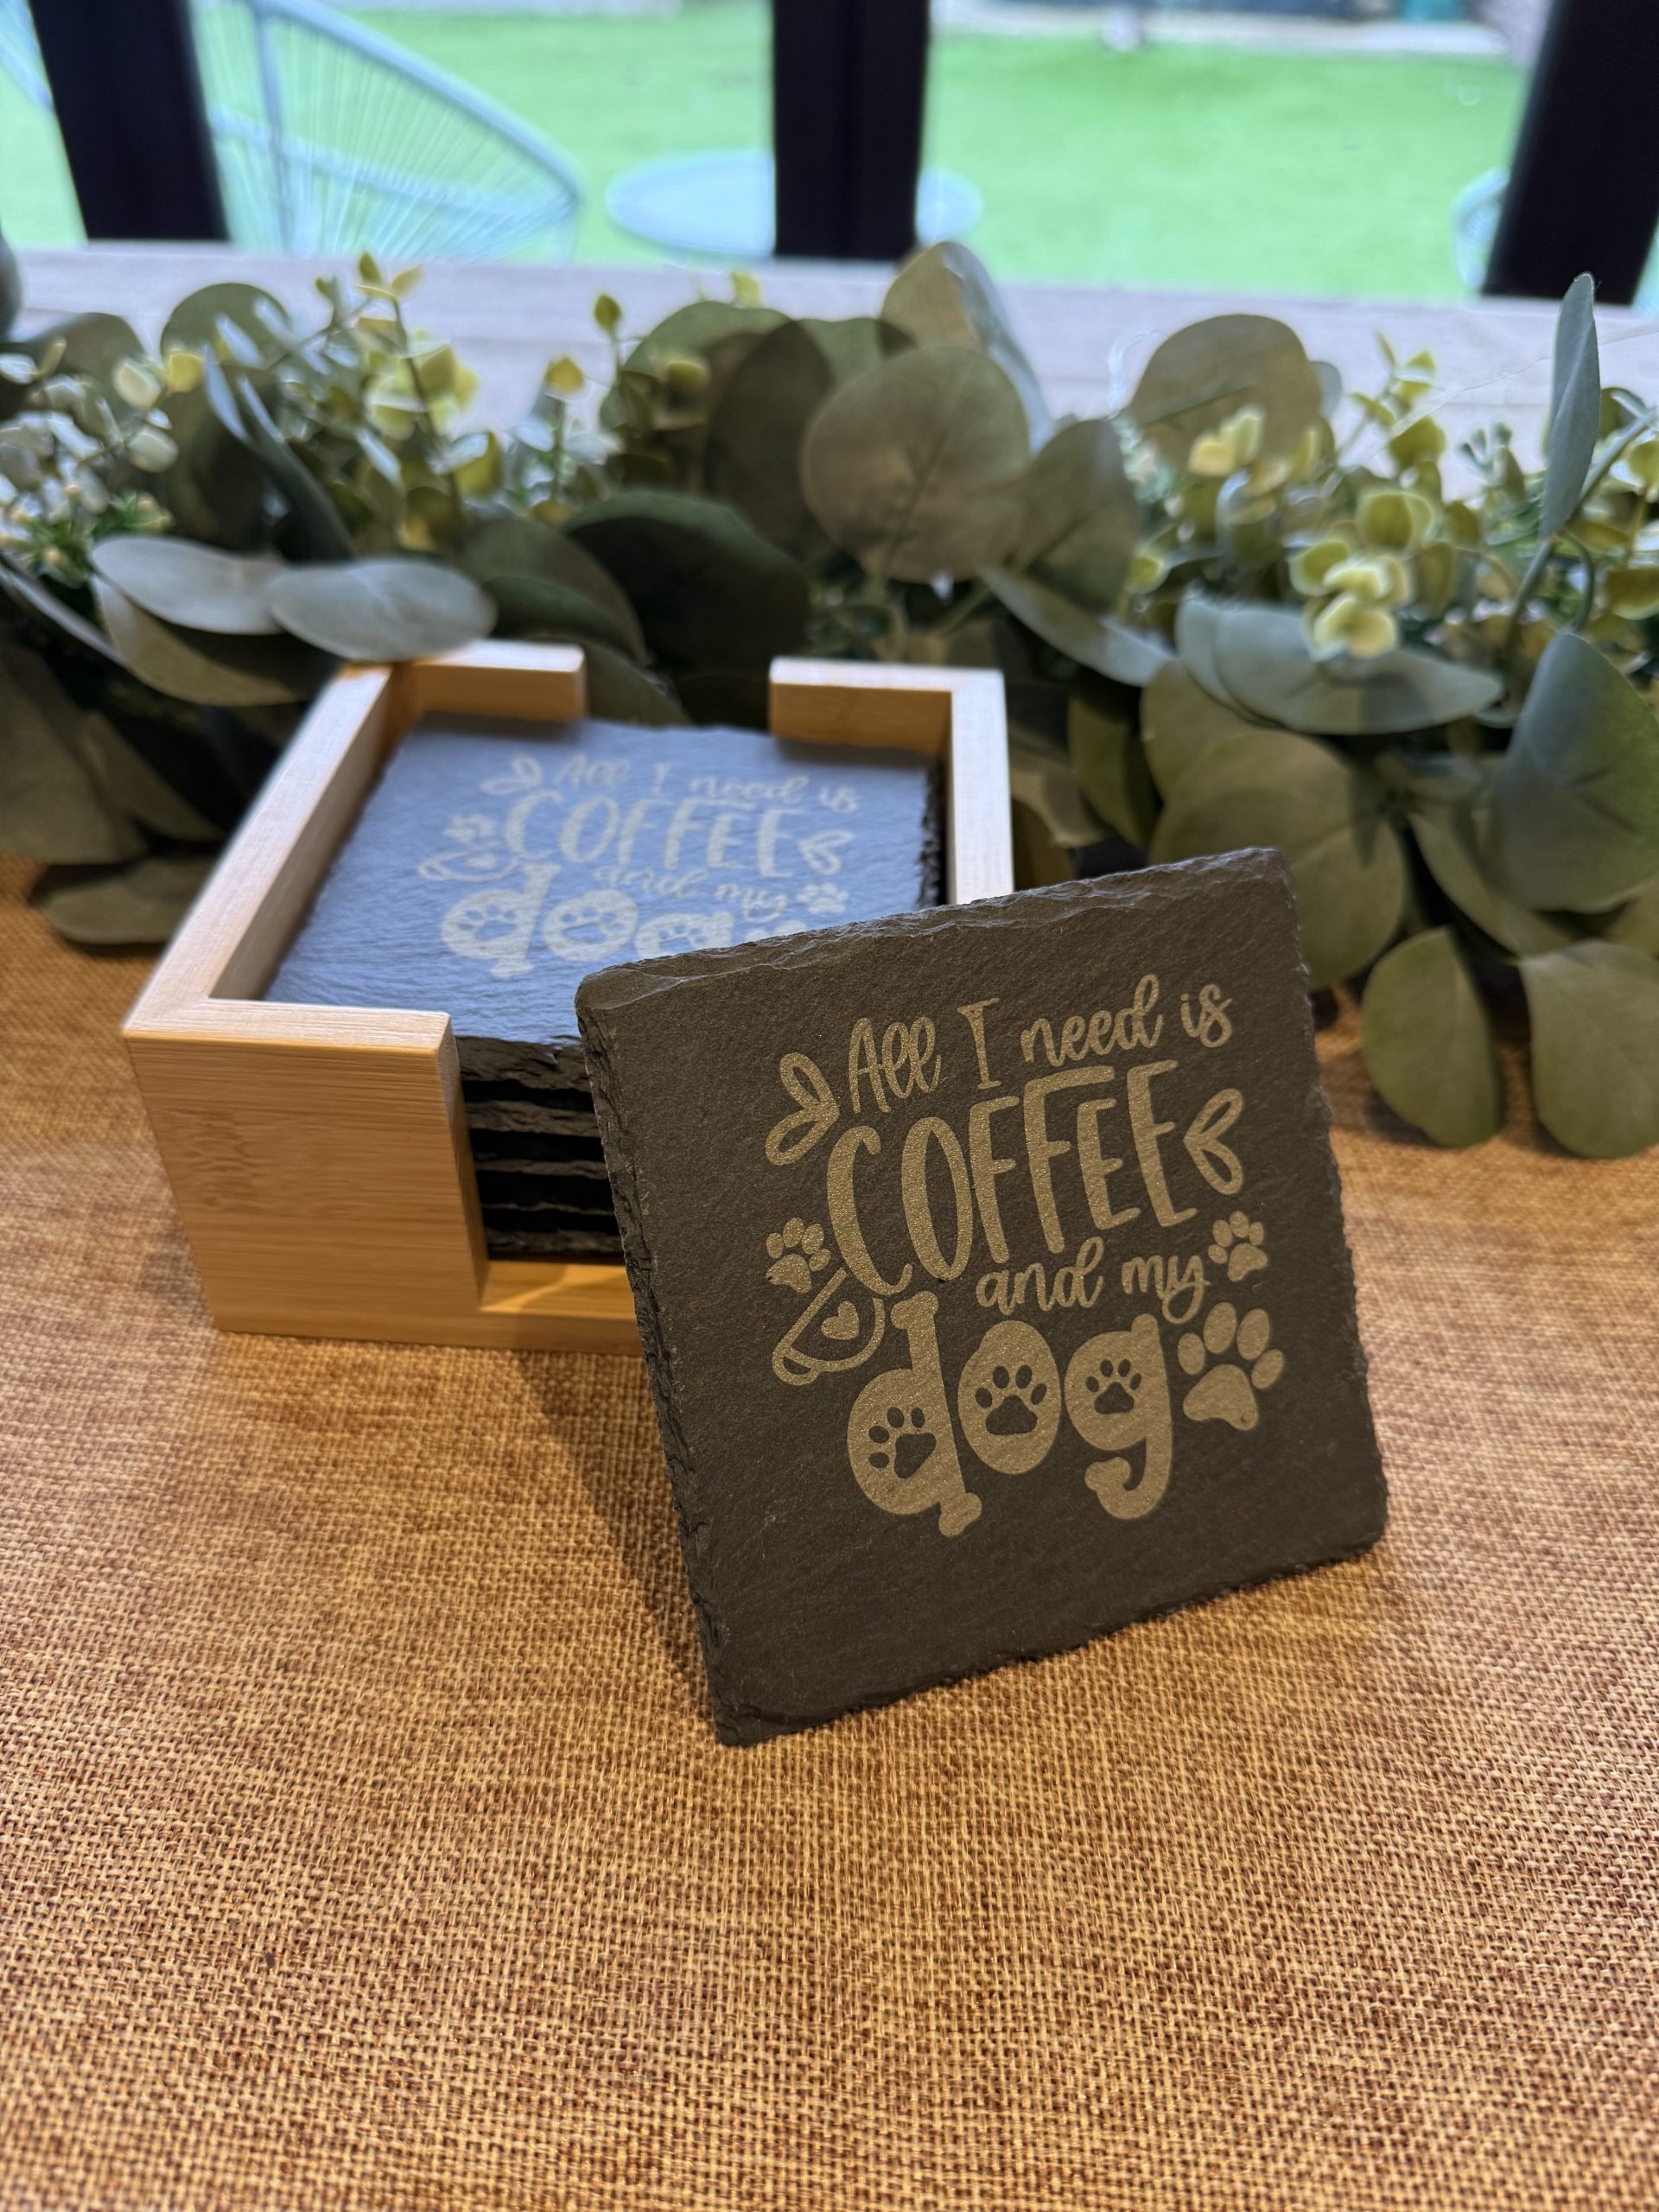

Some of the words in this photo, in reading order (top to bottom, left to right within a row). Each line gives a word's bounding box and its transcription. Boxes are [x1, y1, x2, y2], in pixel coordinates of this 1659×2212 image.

[653, 762, 673, 797] I
[690, 774, 810, 804] need
[818, 786, 860, 814] is
[504, 790, 806, 878] COFFEE
[594, 866, 710, 898] and
[715, 881, 787, 922] my
[849, 1016, 942, 1113] All
[957, 997, 1001, 1090] I
[1020, 974, 1163, 1066] need
[1180, 983, 1233, 1047] is
[826, 1060, 1198, 1295] COFFEE
[976, 1236, 1105, 1313] and
[1122, 1254, 1211, 1324] my
[847, 1290, 1173, 1536] dog
